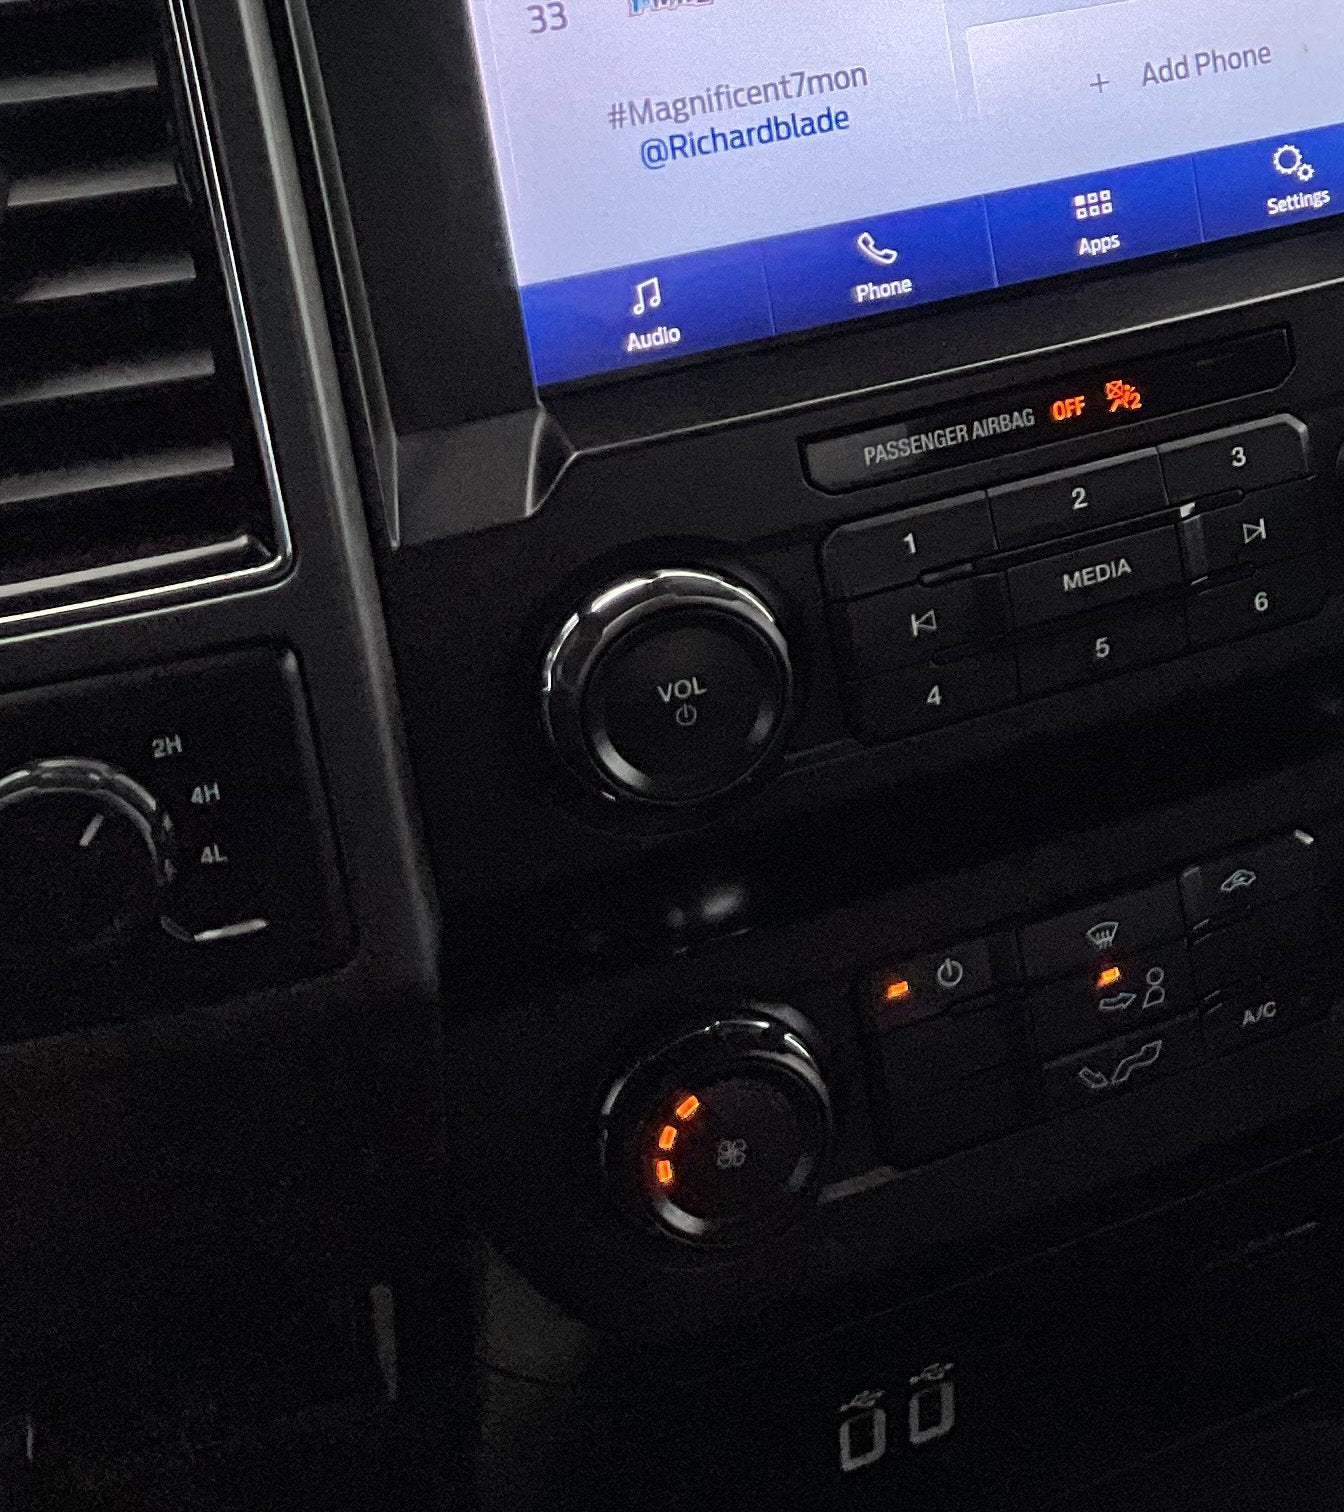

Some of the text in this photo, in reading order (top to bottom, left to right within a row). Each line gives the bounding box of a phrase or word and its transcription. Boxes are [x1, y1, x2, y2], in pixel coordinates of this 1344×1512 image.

[526, 1, 569, 33] 33
[1142, 44, 1272, 86] Add Phone
[607, 65, 868, 130] #Magnificent7mon
[640, 106, 850, 170] @Richardblade
[1267, 188, 1331, 216] Settings
[1078, 233, 1121, 256] Apps
[856, 277, 912, 303] Phone
[627, 326, 681, 351] Audio
[864, 395, 1086, 467] PASSENGER AIRBAG OFF
[1231, 446, 1247, 468] 3
[1072, 488, 1089, 509] 2
[902, 532, 918, 555] 1
[1063, 558, 1132, 592] MEDIA
[1254, 592, 1269, 612] 6
[1095, 637, 1110, 658] 5
[657, 676, 708, 703] VOL
[926, 685, 943, 705] 4
[151, 734, 182, 758] 2H
[190, 782, 221, 804] 4H
[200, 843, 228, 864] 4L
[1242, 1000, 1277, 1026] A/C
